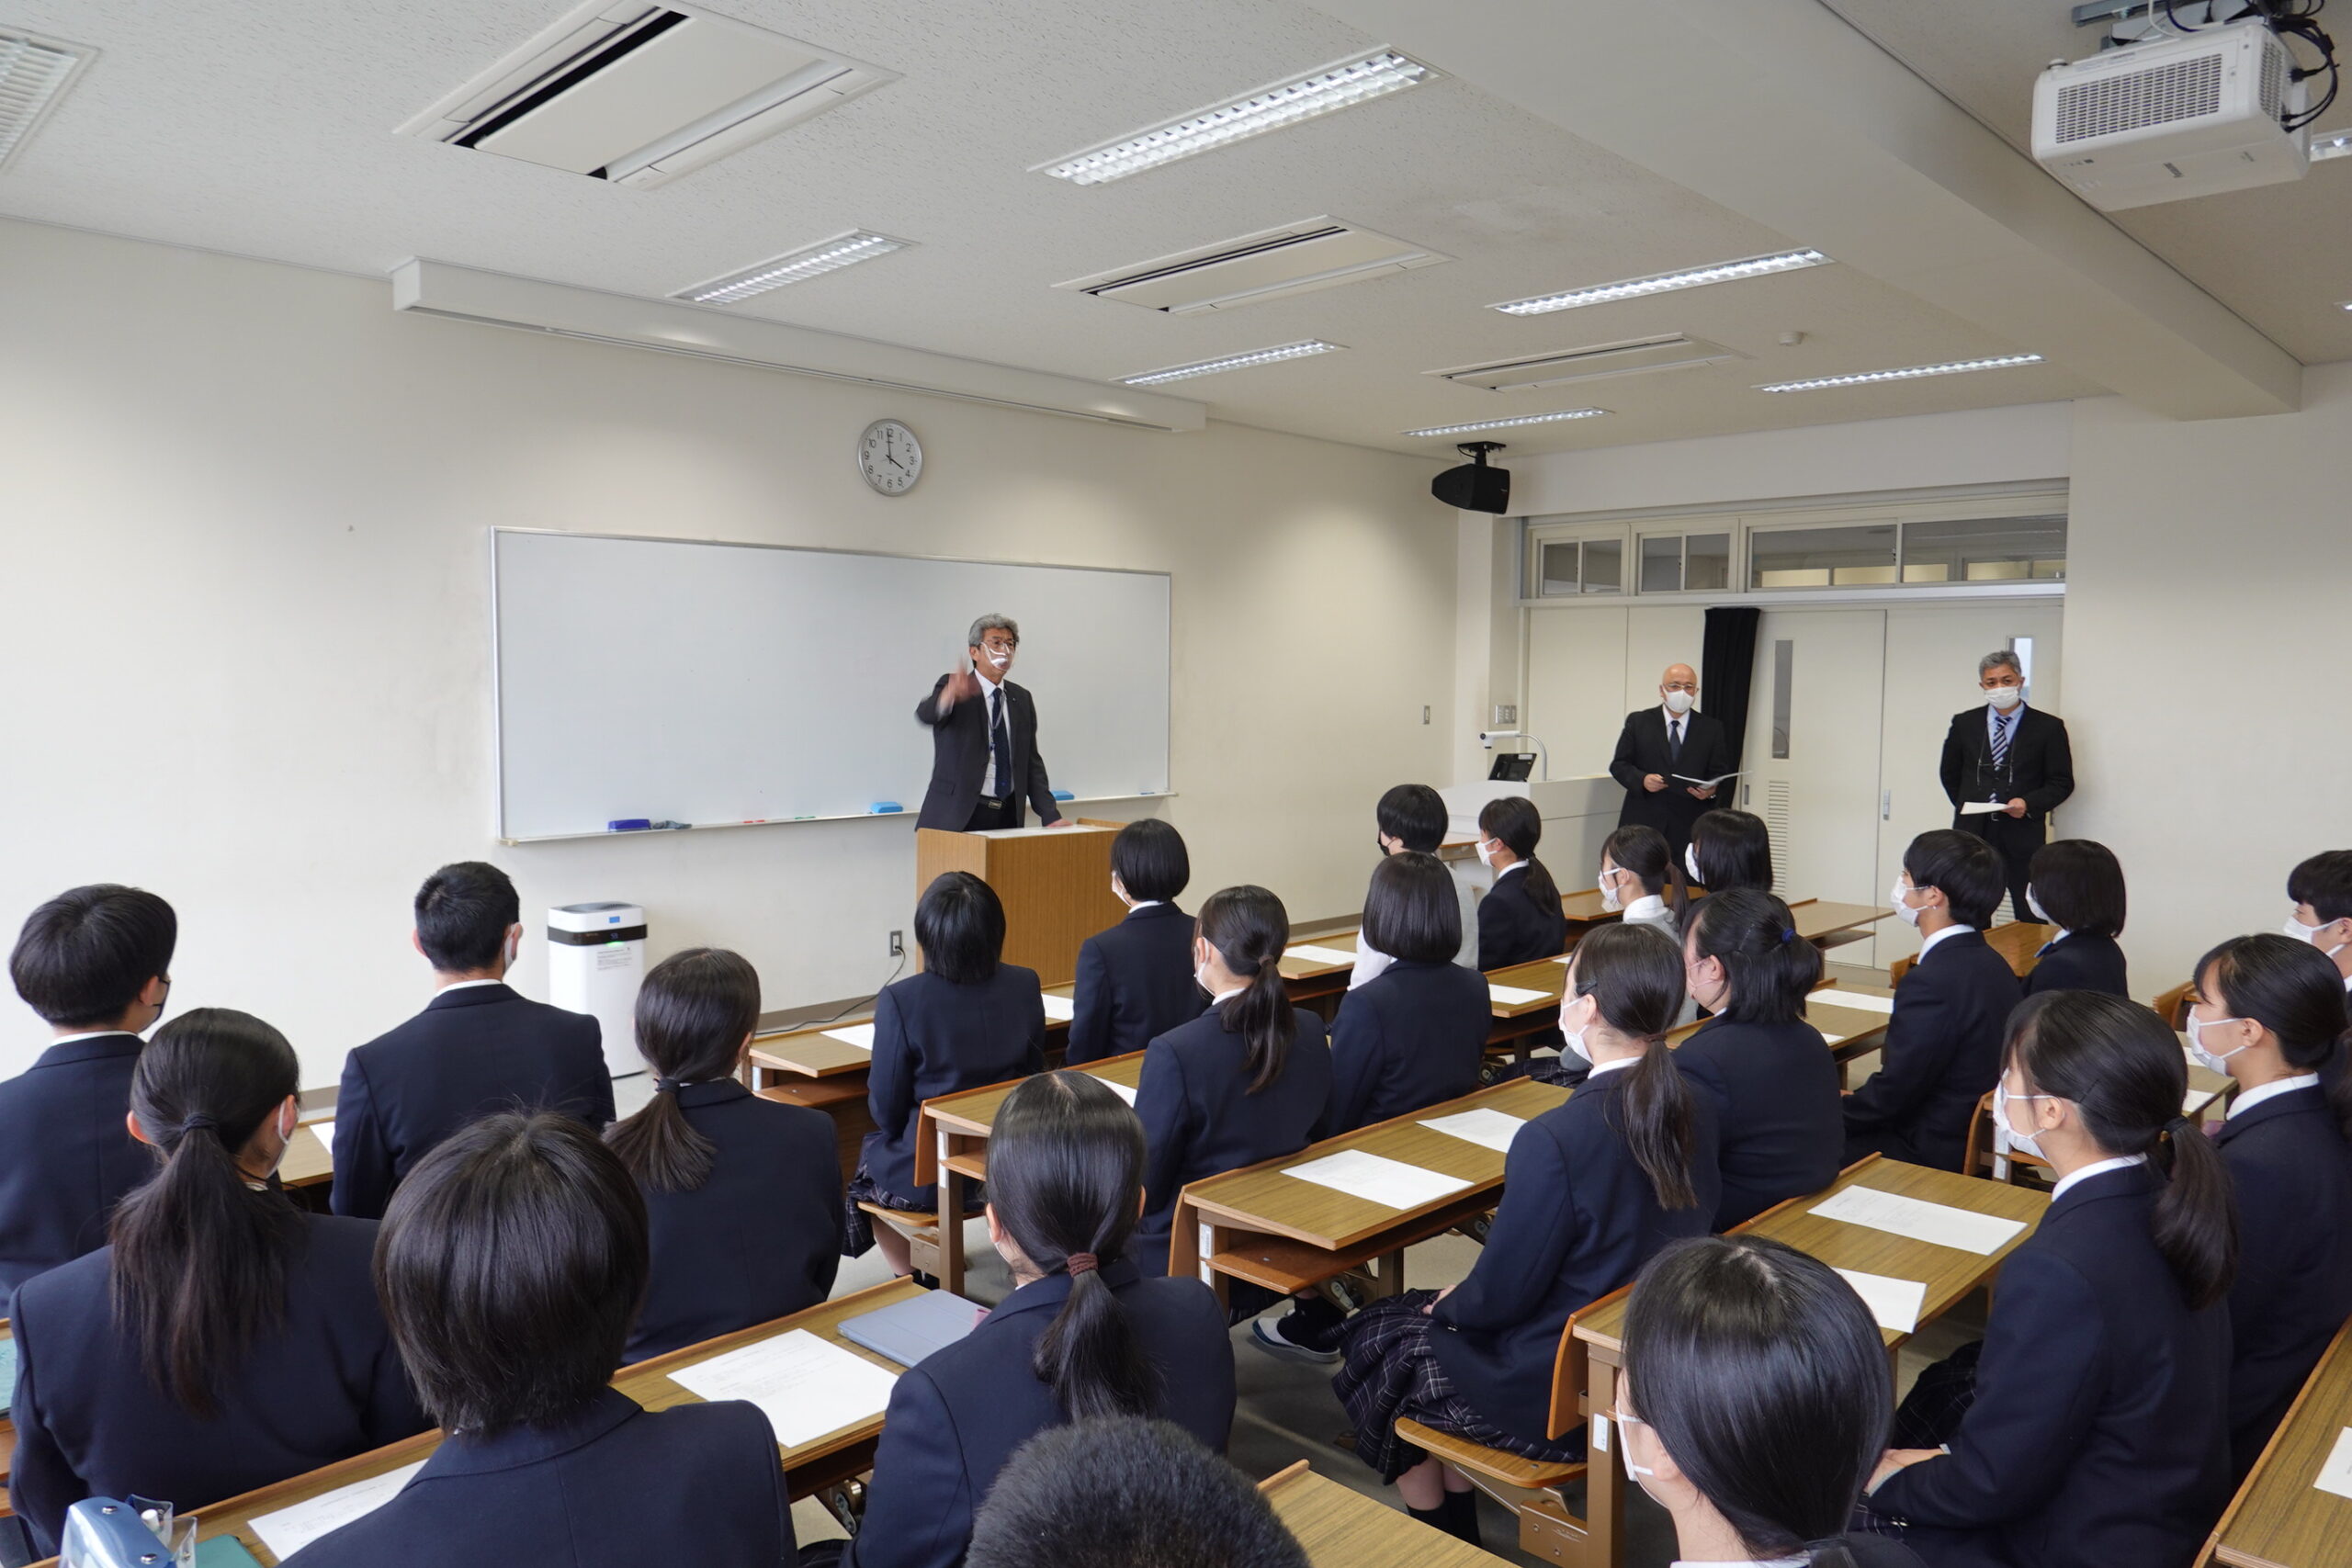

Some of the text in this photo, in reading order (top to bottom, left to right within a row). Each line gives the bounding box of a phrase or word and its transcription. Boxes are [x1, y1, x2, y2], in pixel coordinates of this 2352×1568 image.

[868, 438, 876, 448] 10
[906, 443, 911, 453] 2
[865, 450, 870, 460] 9
[910, 456, 914, 466] 3
[867, 465, 874, 474] 8
[877, 474, 882, 484] 7
[887, 479, 893, 489] 6
[898, 476, 903, 486] 5
